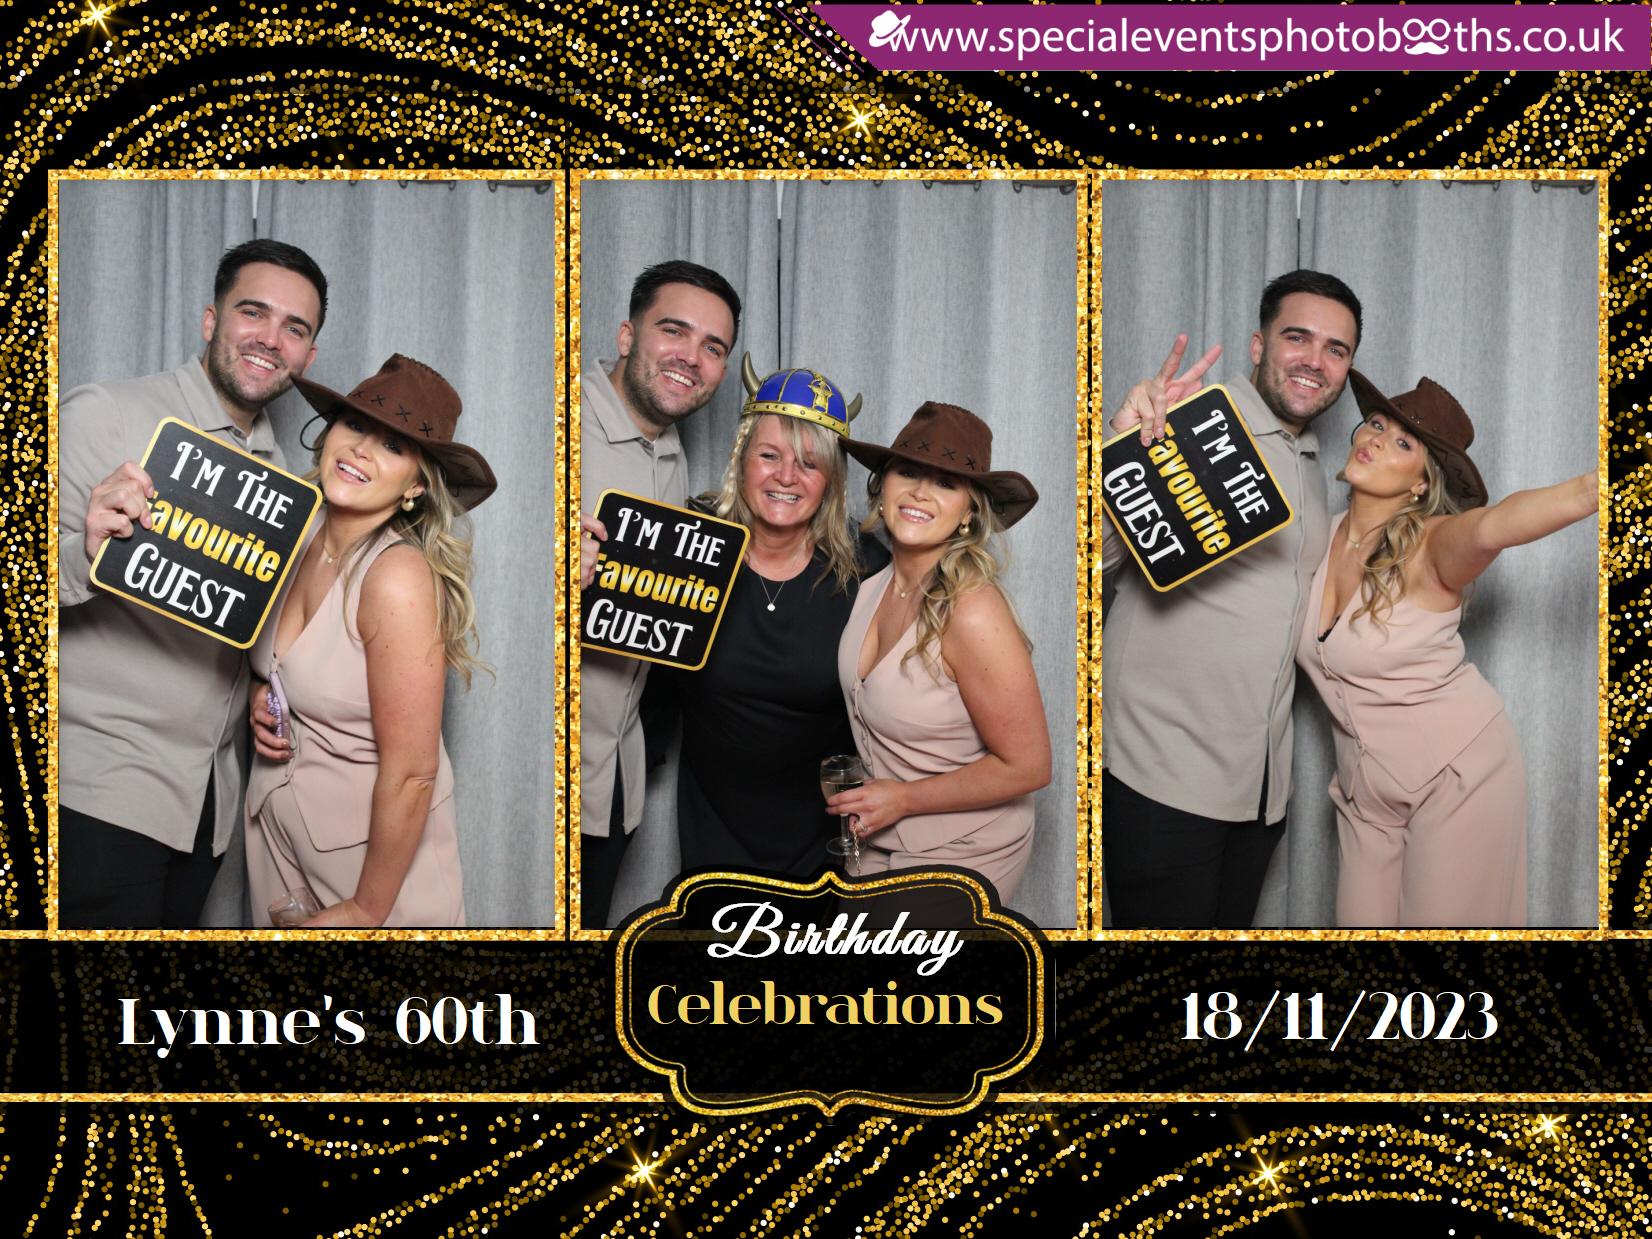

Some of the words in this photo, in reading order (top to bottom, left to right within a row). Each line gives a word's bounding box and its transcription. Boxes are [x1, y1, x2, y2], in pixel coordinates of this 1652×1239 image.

[233, 470, 294, 529] THE
[1103, 461, 1186, 564] GUEST
[1222, 461, 1271, 524] THE
[146, 491, 281, 583] avourite
[673, 520, 726, 567] THE
[124, 542, 246, 628] GUEST
[585, 598, 694, 657] GUEST
